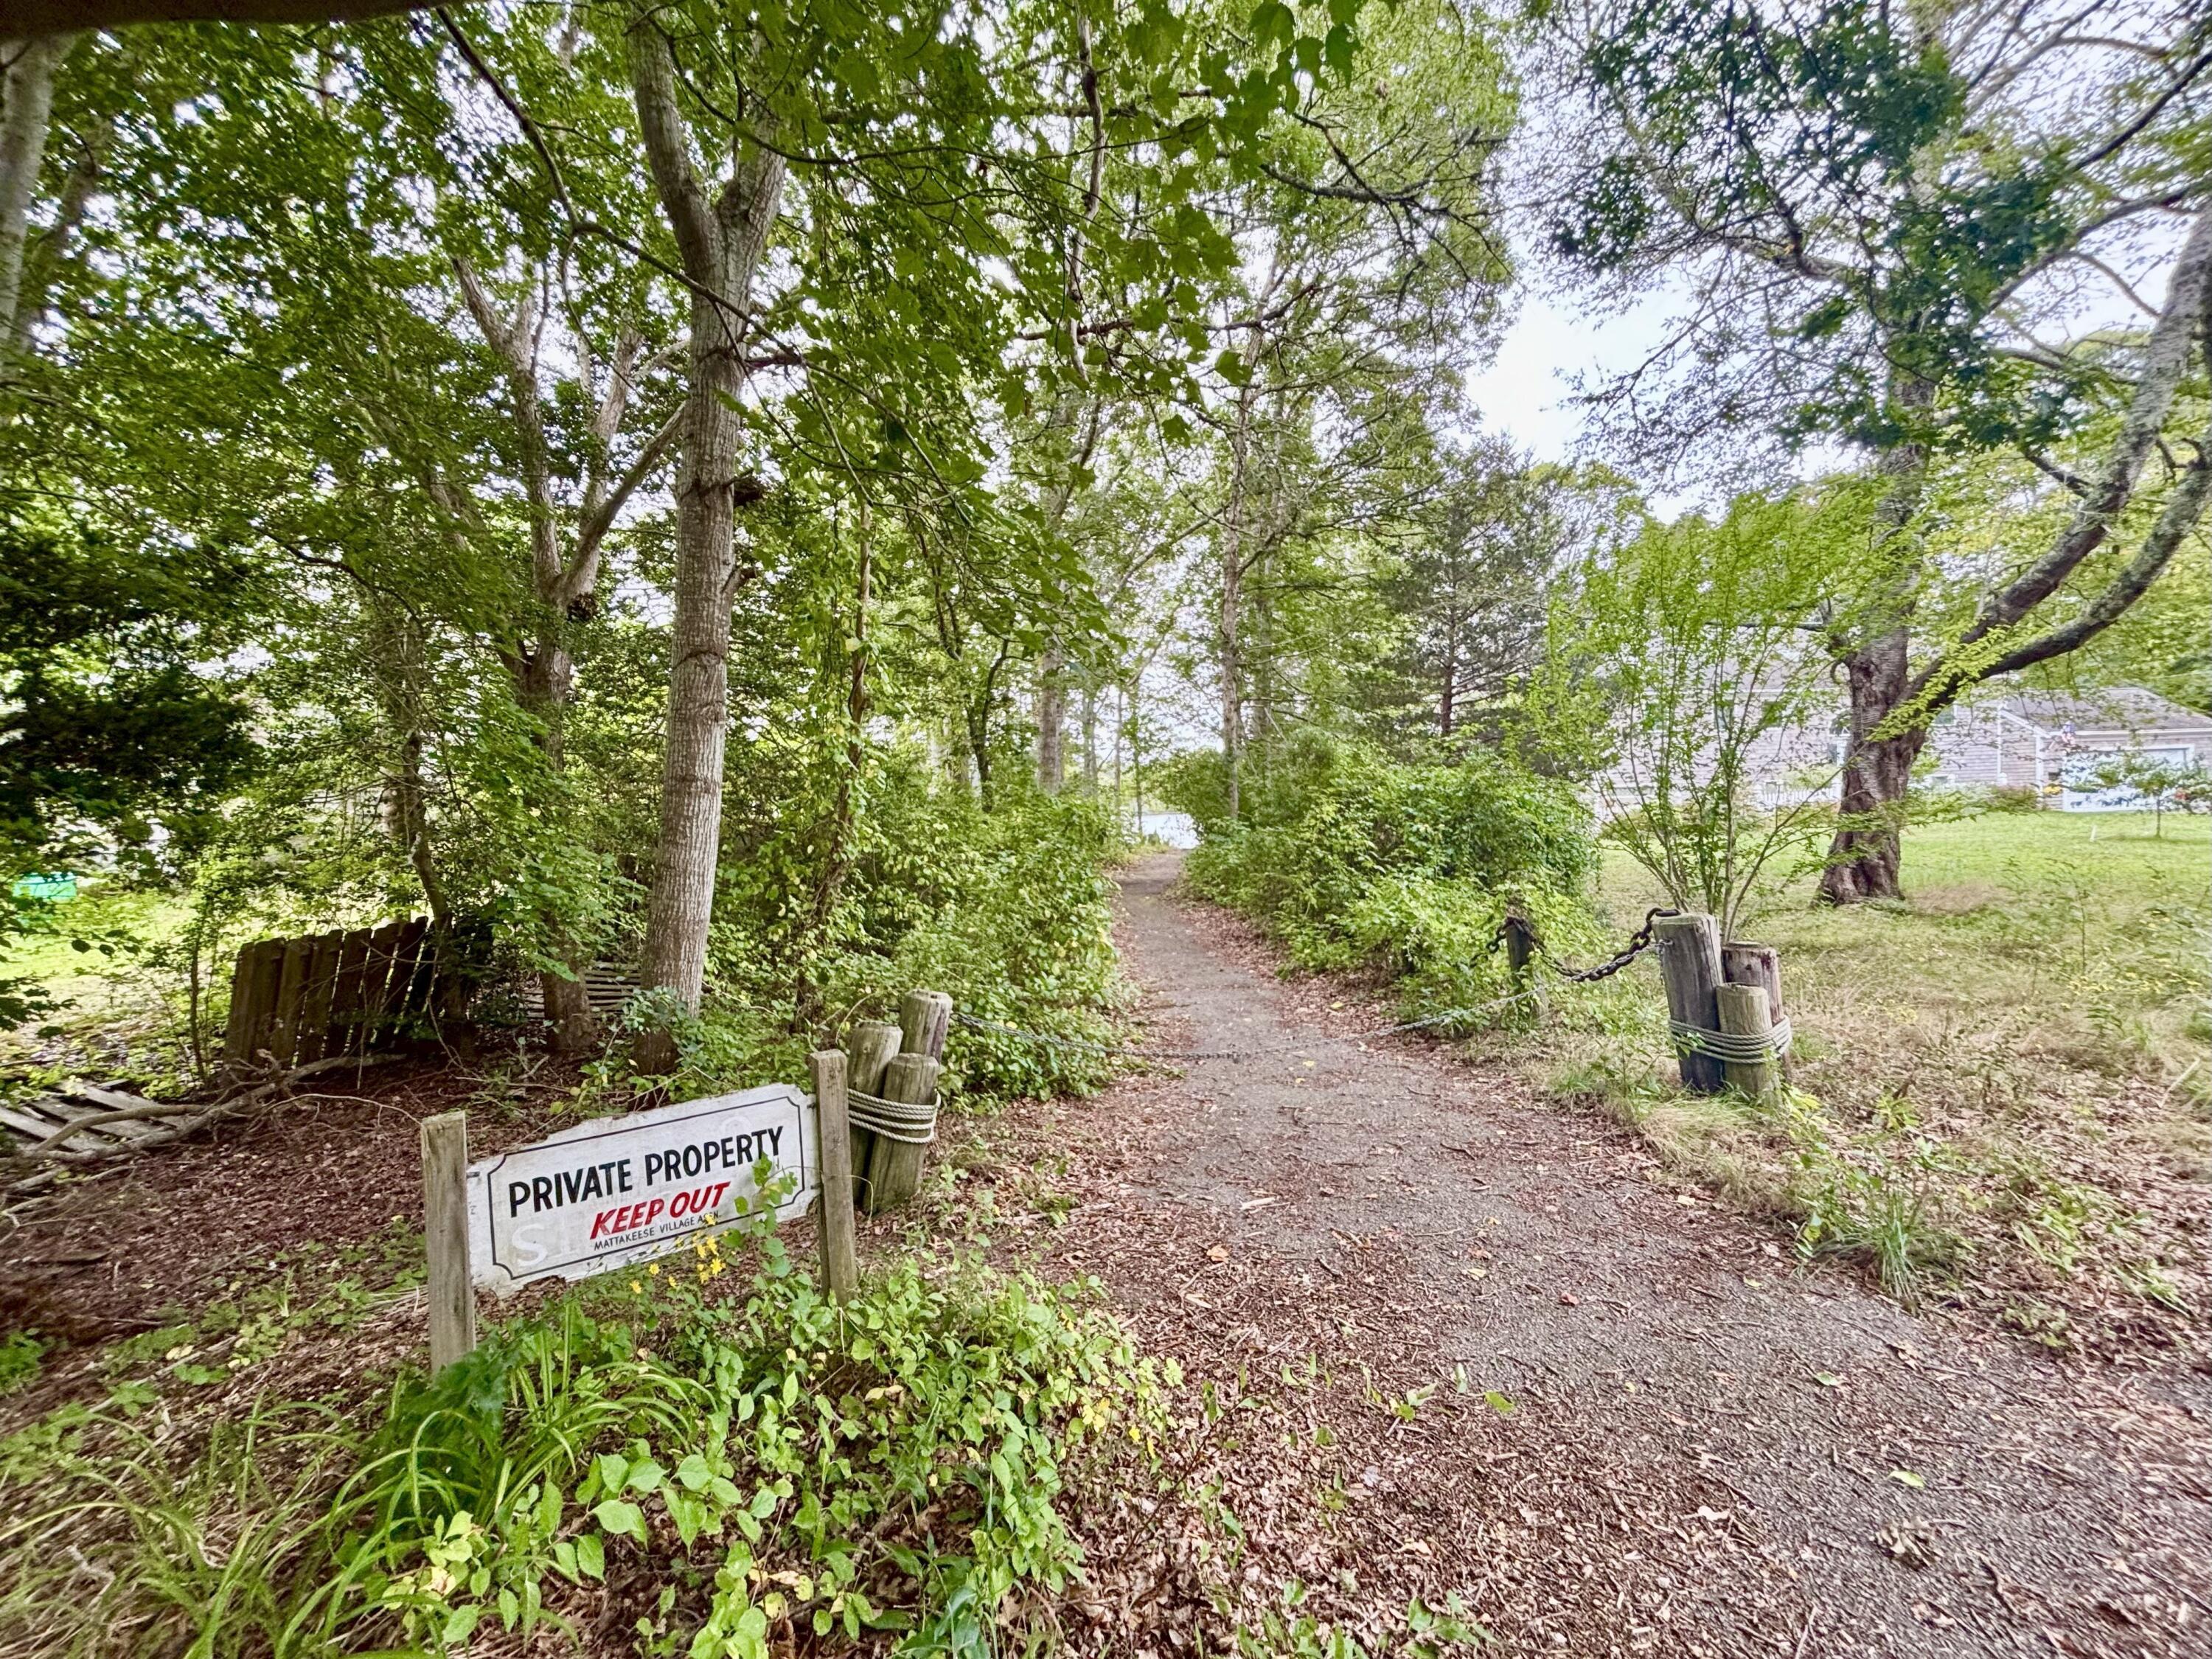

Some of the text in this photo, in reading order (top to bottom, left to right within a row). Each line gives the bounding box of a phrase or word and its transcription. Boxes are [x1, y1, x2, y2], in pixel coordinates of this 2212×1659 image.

[509, 1126, 784, 1218] PRIVATE PROPERTY
[590, 1181, 731, 1240] KEEP OUT
[594, 1227, 655, 1251] MATTAKEESE
[659, 1217, 695, 1234] VILLAGE
